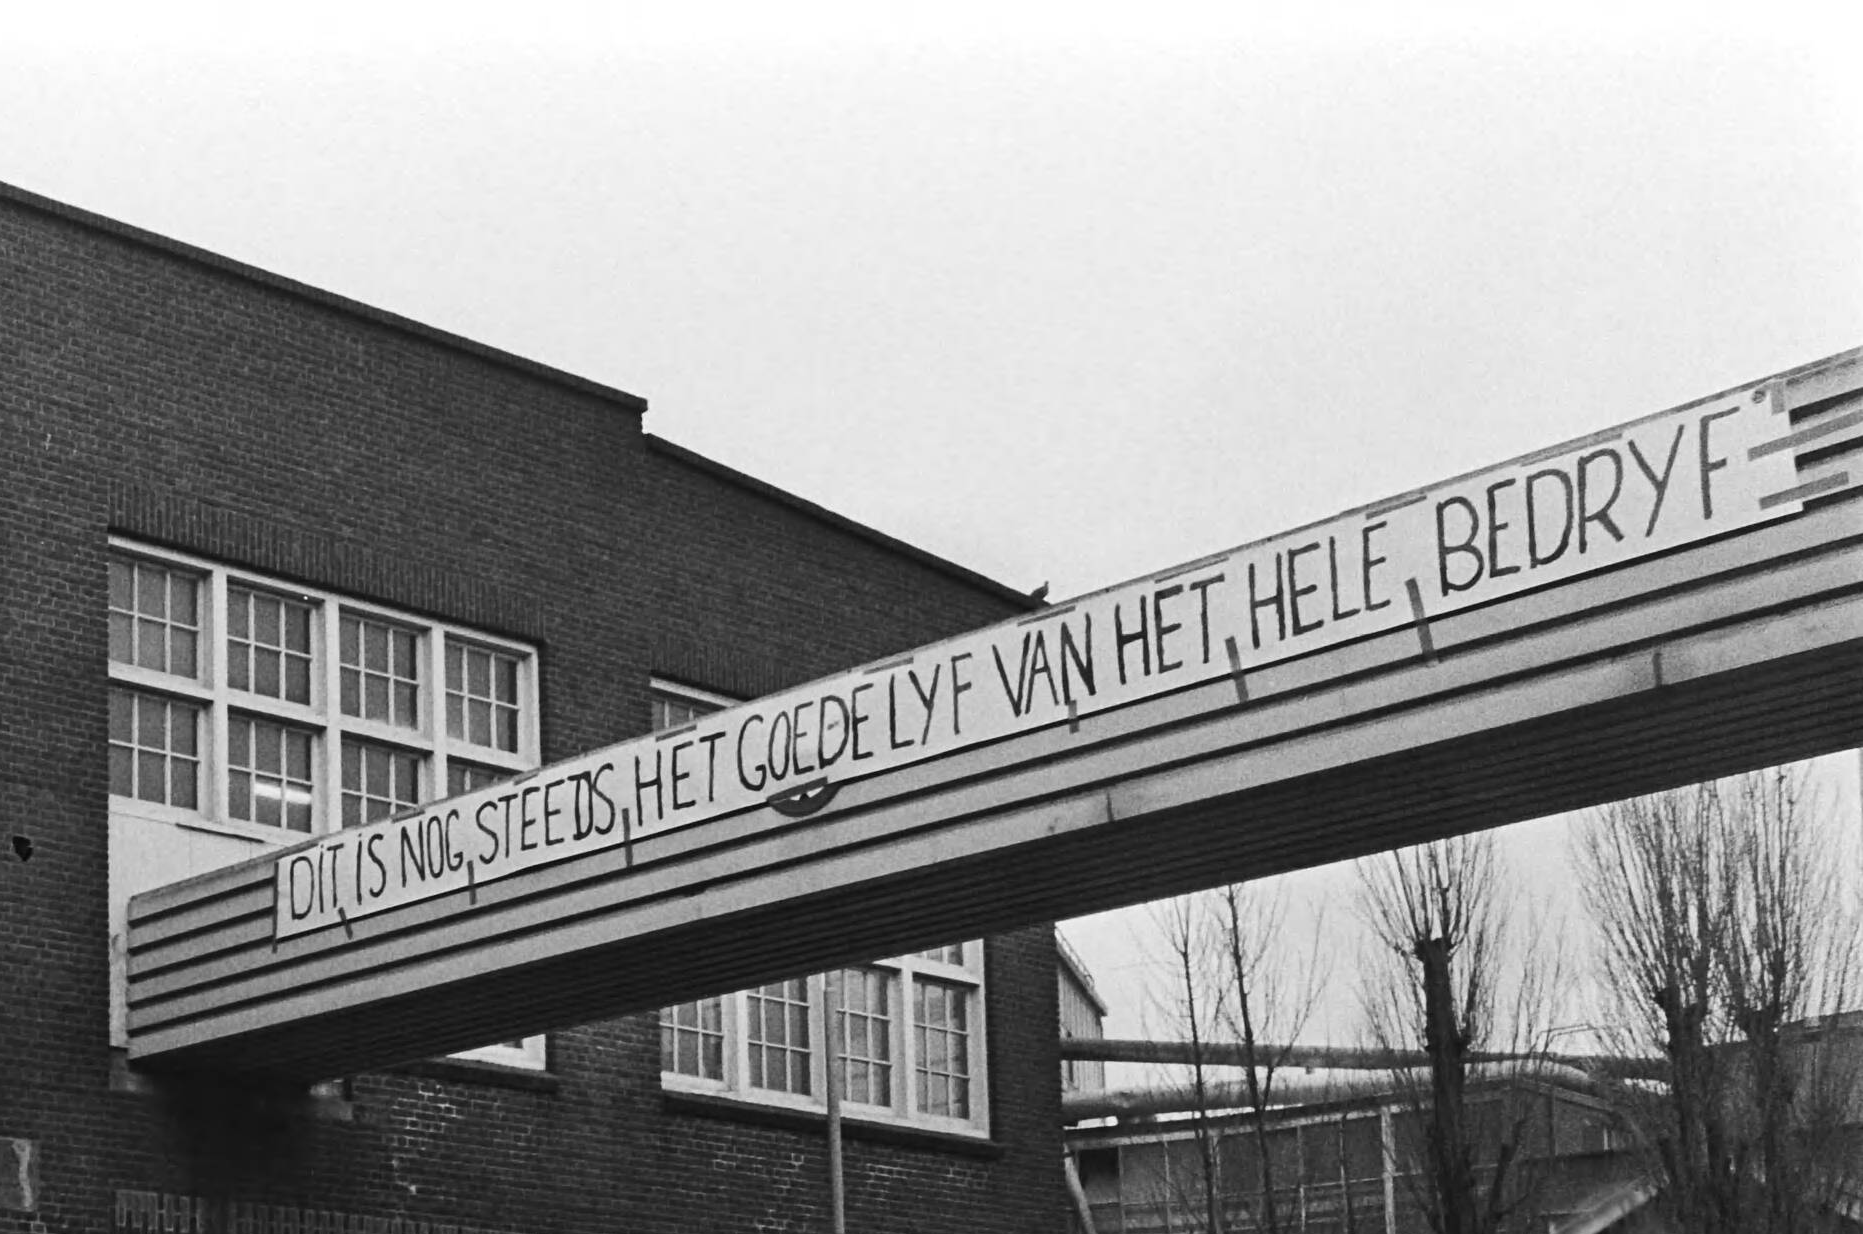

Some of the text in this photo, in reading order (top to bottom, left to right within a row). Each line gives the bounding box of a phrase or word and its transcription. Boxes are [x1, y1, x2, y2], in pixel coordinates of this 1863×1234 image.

[289, 843, 344, 920] DIT
[356, 833, 386, 905] IS
[401, 809, 463, 888] NOG
[475, 762, 615, 864] STEEDS
[635, 731, 726, 827] HET
[992, 612, 1097, 718] VAN
[1115, 573, 1225, 685] HET
[1248, 520, 1391, 650] HELE
[1436, 405, 1740, 597] BEDRYF
